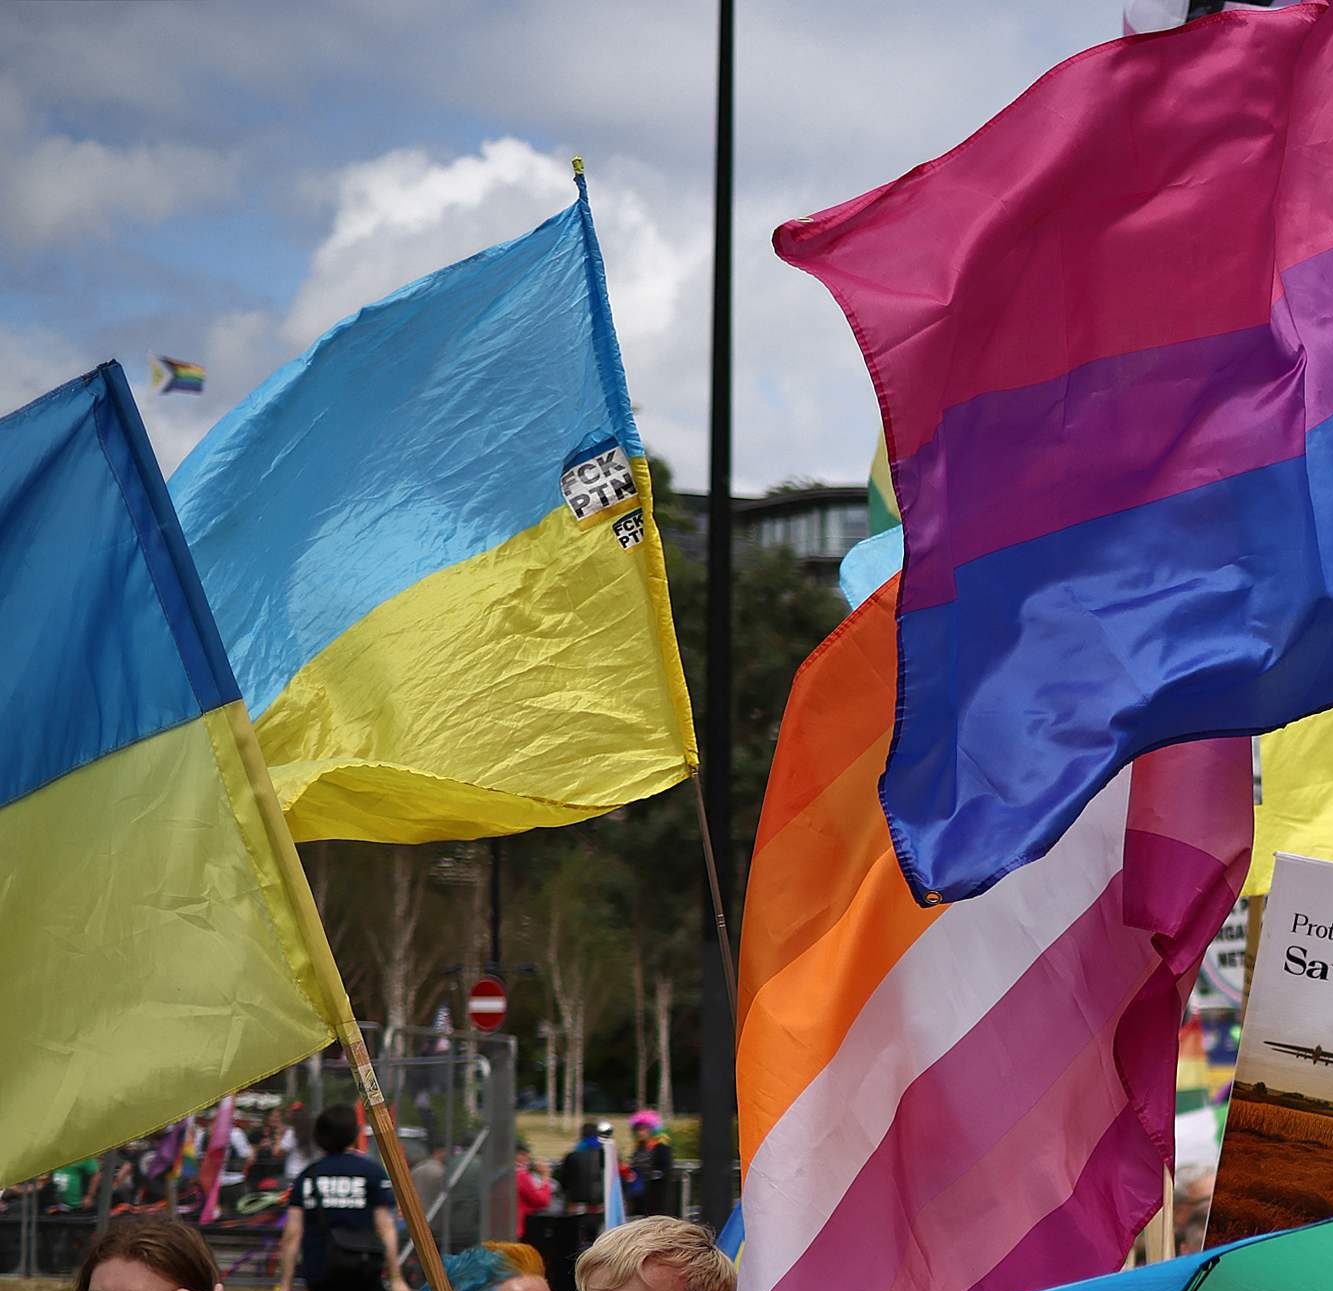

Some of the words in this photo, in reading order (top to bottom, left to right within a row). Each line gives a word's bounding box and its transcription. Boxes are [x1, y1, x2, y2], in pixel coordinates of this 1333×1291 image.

[561, 450, 626, 497] FCK
[569, 472, 638, 519] PTN
[614, 514, 644, 537] FCK
